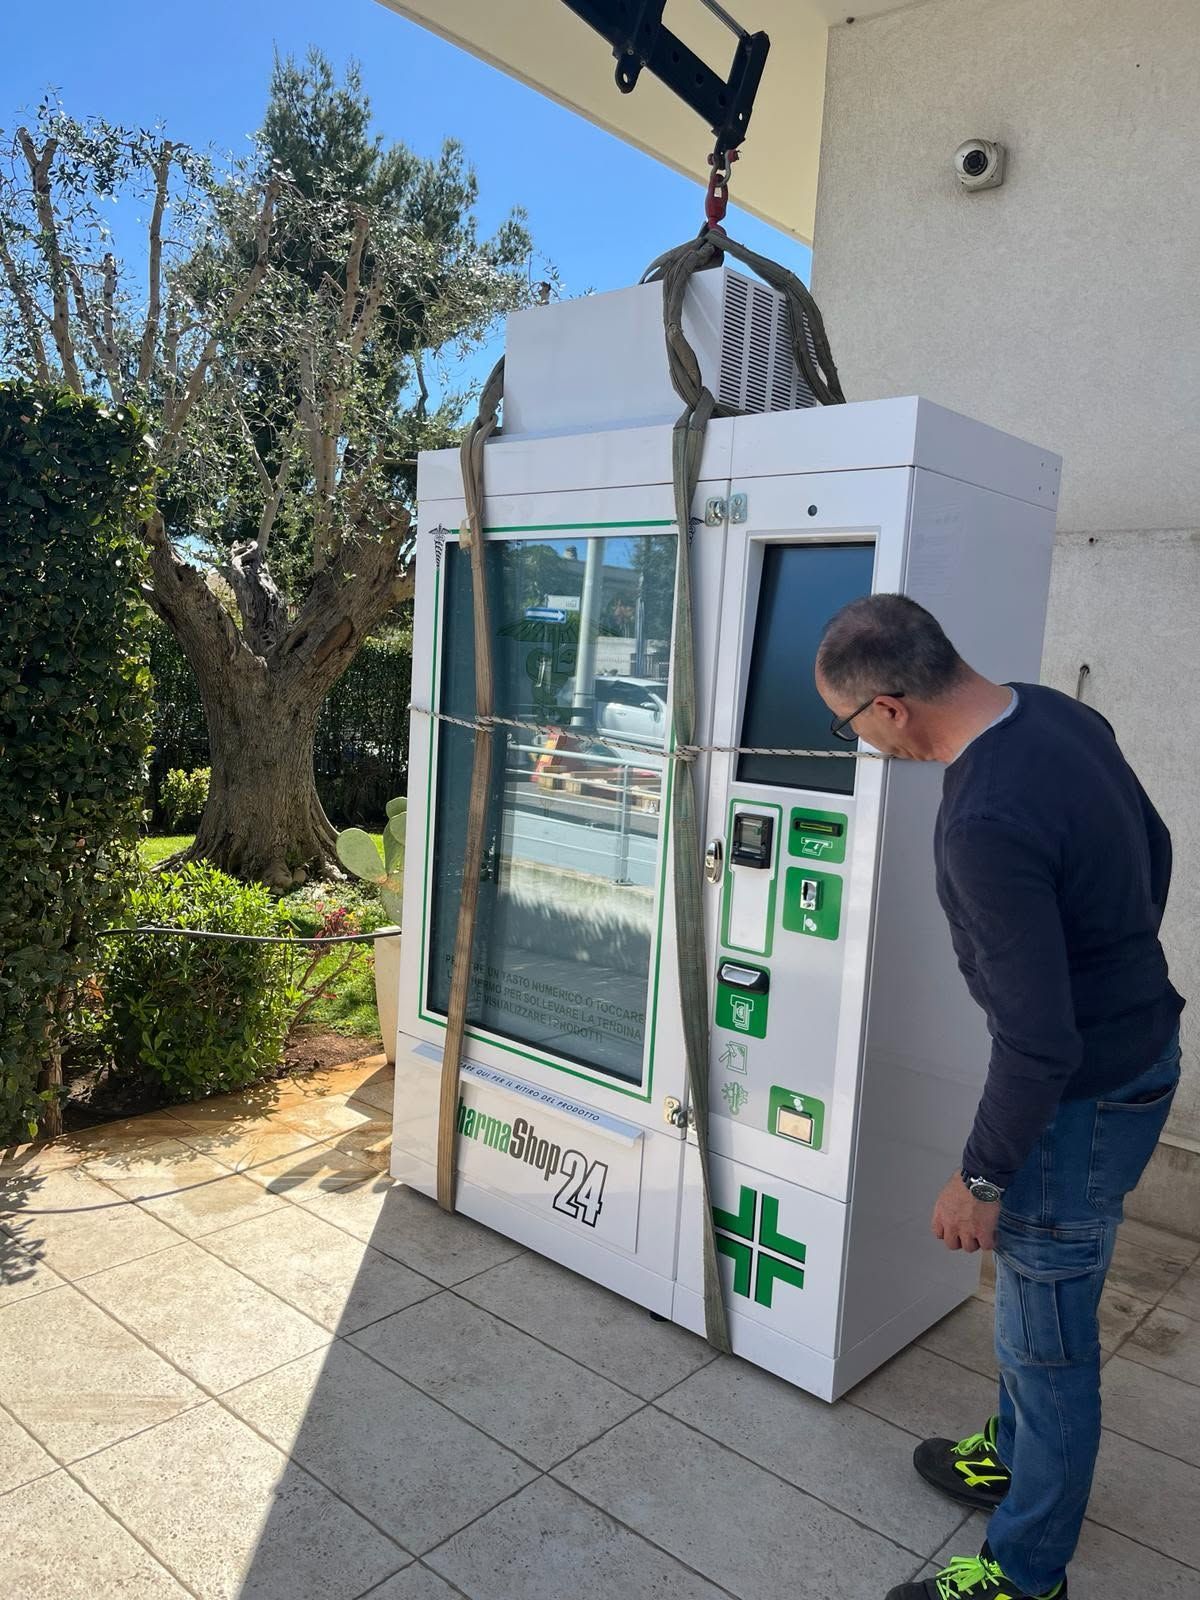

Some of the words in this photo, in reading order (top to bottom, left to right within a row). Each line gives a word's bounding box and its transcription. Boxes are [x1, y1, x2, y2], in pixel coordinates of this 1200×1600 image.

[502, 971, 530, 989] TASTO
[532, 980, 583, 1005] NUMERICO
[597, 1001, 646, 1025] TOCCARE
[503, 987, 522, 1001] PER
[524, 992, 579, 1021] SOLLEVARE
[581, 1011, 595, 1025] LA
[598, 1016, 643, 1041] TENDINA
[475, 1068, 490, 1079] QUI
[491, 1074, 506, 1085] PER
[507, 1080, 513, 1089] IL
[515, 1083, 541, 1099] RITIRO
[541, 1094, 557, 1105] DEL
[557, 1100, 601, 1123] PRODOTTO
